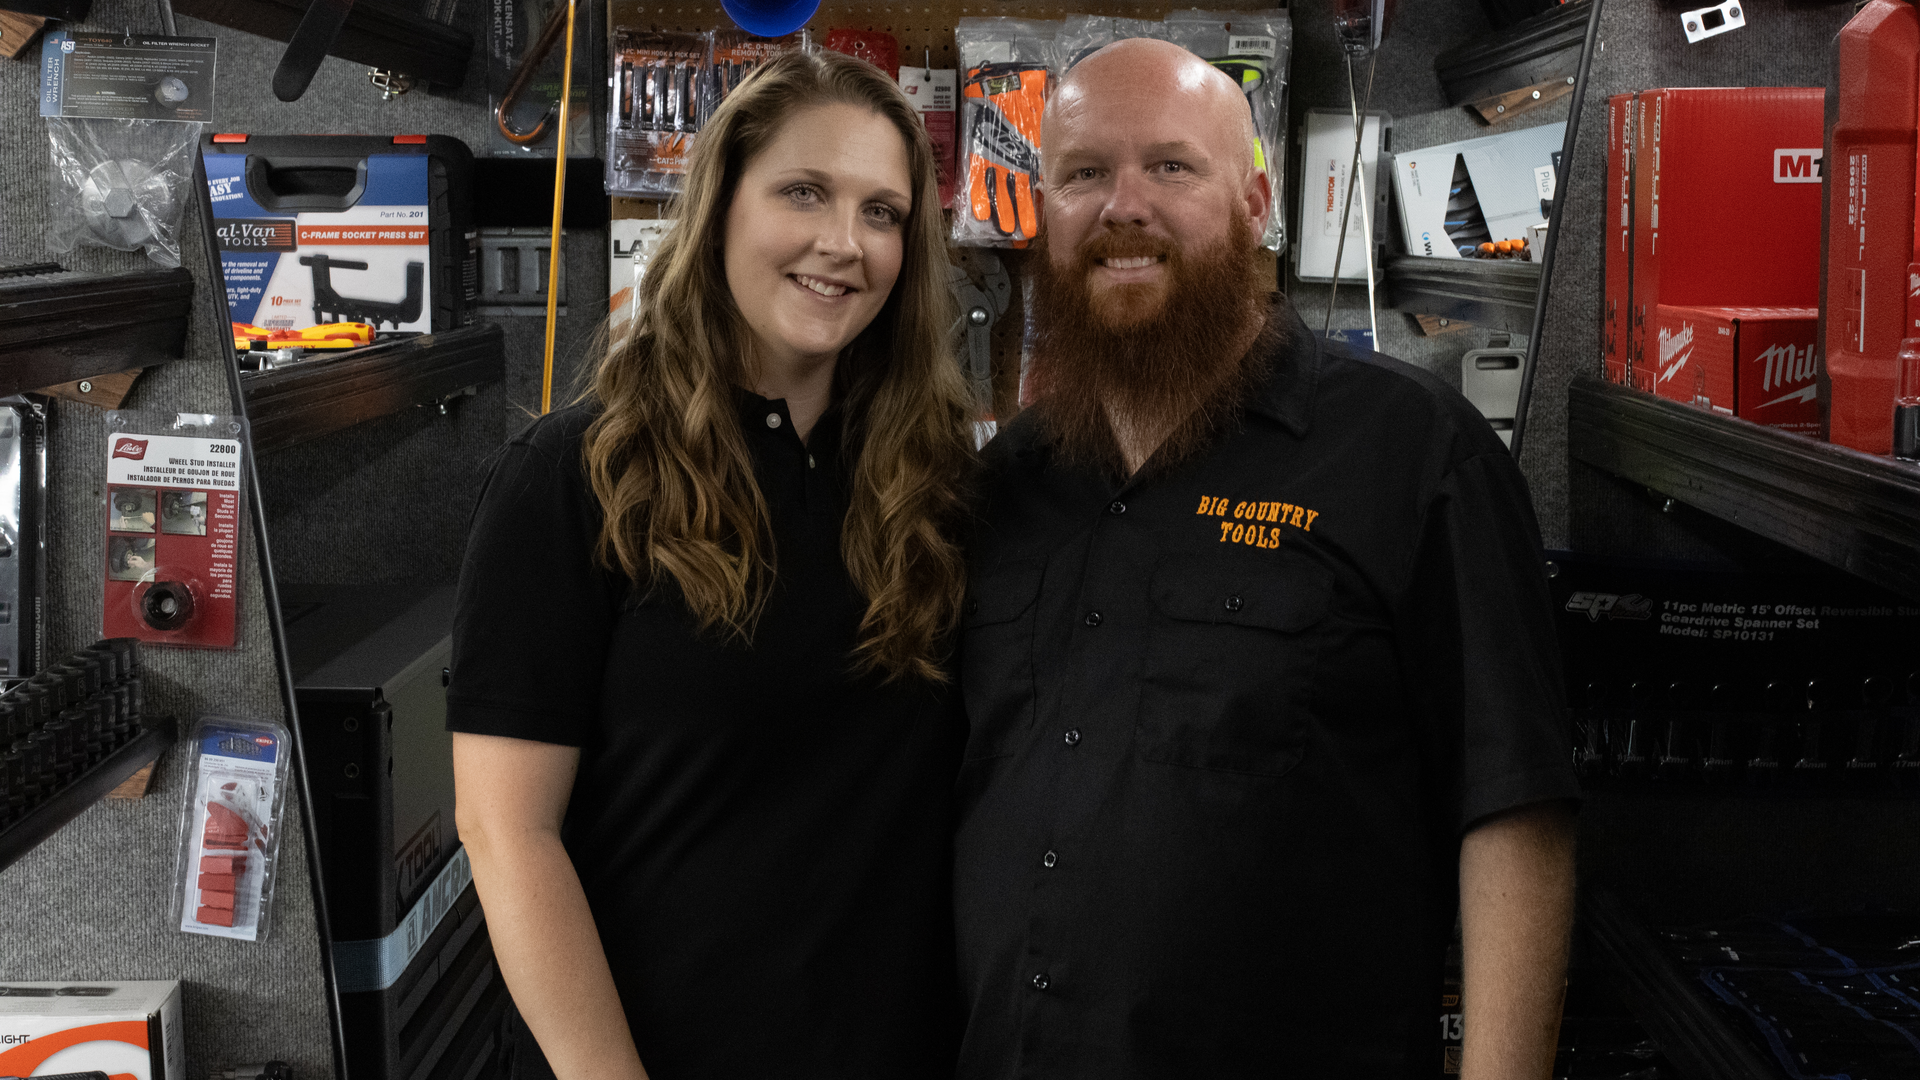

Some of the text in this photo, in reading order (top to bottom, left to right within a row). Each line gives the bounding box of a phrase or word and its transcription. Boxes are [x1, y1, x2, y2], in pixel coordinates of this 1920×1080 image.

[61, 41, 76, 50] AST
[1540, 171, 1550, 192] Plus
[1327, 176, 1335, 212] THEXTON
[217, 224, 276, 237] al-Van
[224, 238, 268, 246] TOOLS
[271, 296, 282, 306] 10
[1658, 320, 1694, 370] Milwaukee
[210, 444, 236, 454] 22800
[169, 458, 236, 468] WHEEL STUD INSTALLER
[144, 466, 176, 474] INSTALLEUR
[127, 474, 162, 482] INSTALADOR
[212, 478, 235, 486] RUEDAS
[1196, 495, 1319, 532] BIG COUNTRY
[1220, 521, 1280, 549] TOOLS
[1663, 601, 1697, 613] 11pc
[1702, 602, 1746, 614] Metric
[1774, 605, 1816, 616] Offset
[1820, 606, 1893, 616] Reversible
[1661, 613, 1730, 626] Geardrive
[1734, 617, 1792, 629] Spanner
[1796, 618, 1820, 629] Set
[1660, 624, 1774, 641] Model: SP10131
[0, 1034, 30, 1044] IGHT
